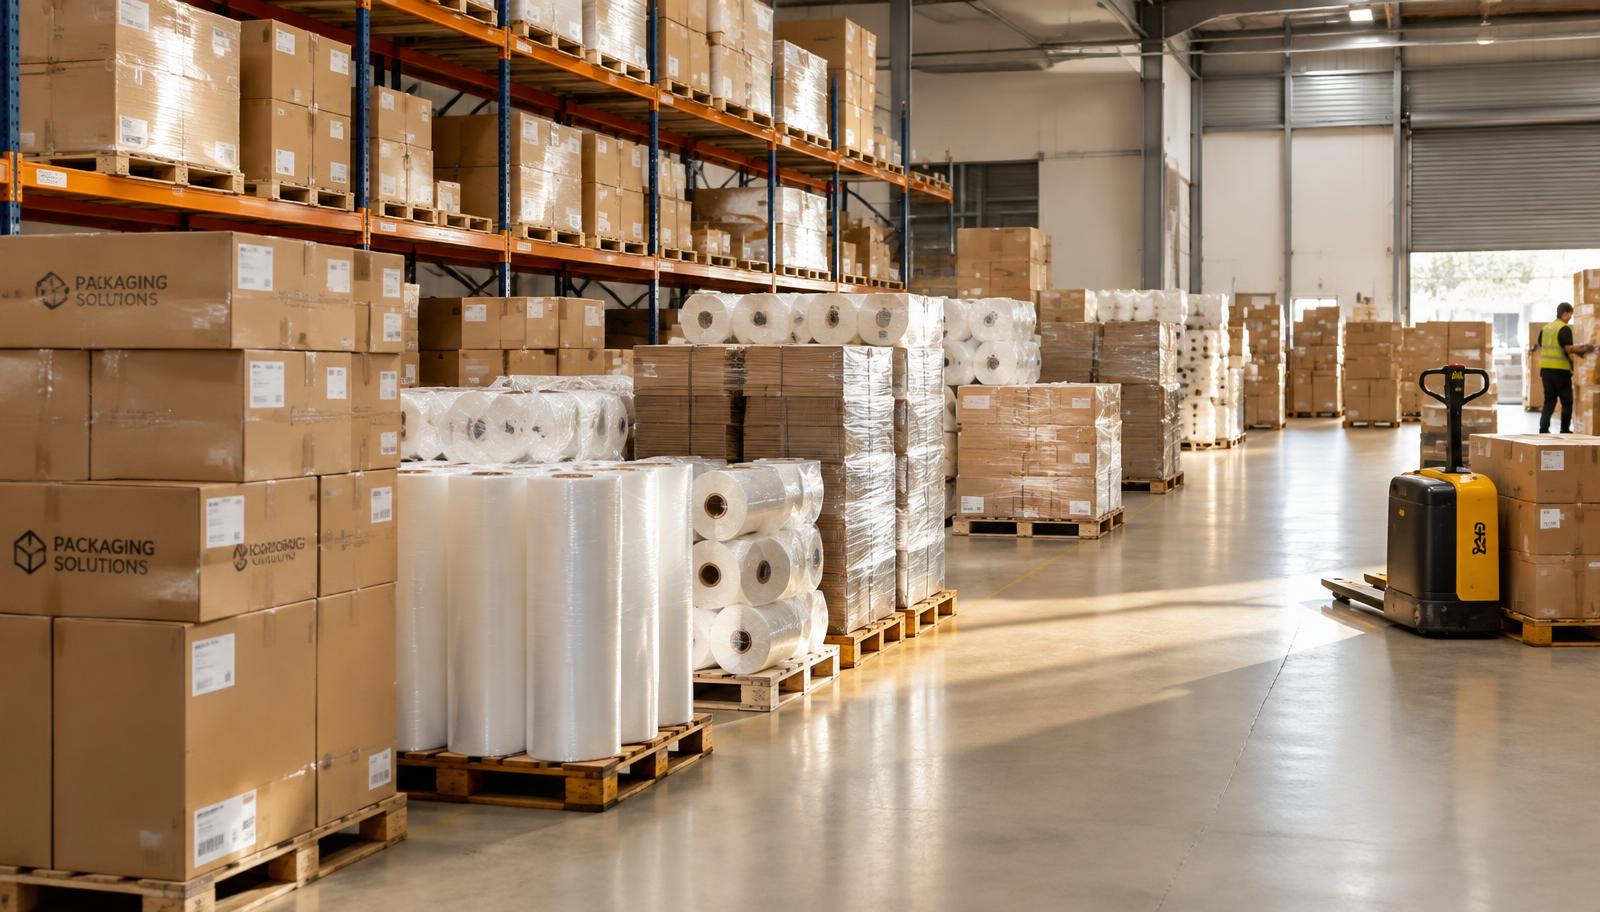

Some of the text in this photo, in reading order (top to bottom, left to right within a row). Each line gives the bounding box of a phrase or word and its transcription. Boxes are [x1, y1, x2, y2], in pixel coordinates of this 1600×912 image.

[75, 274, 168, 291] PACKAGING
[76, 292, 158, 307] SOLUTIONS
[53, 535, 155, 556] PACKAGING
[54, 556, 149, 575] SOLUTIONS
